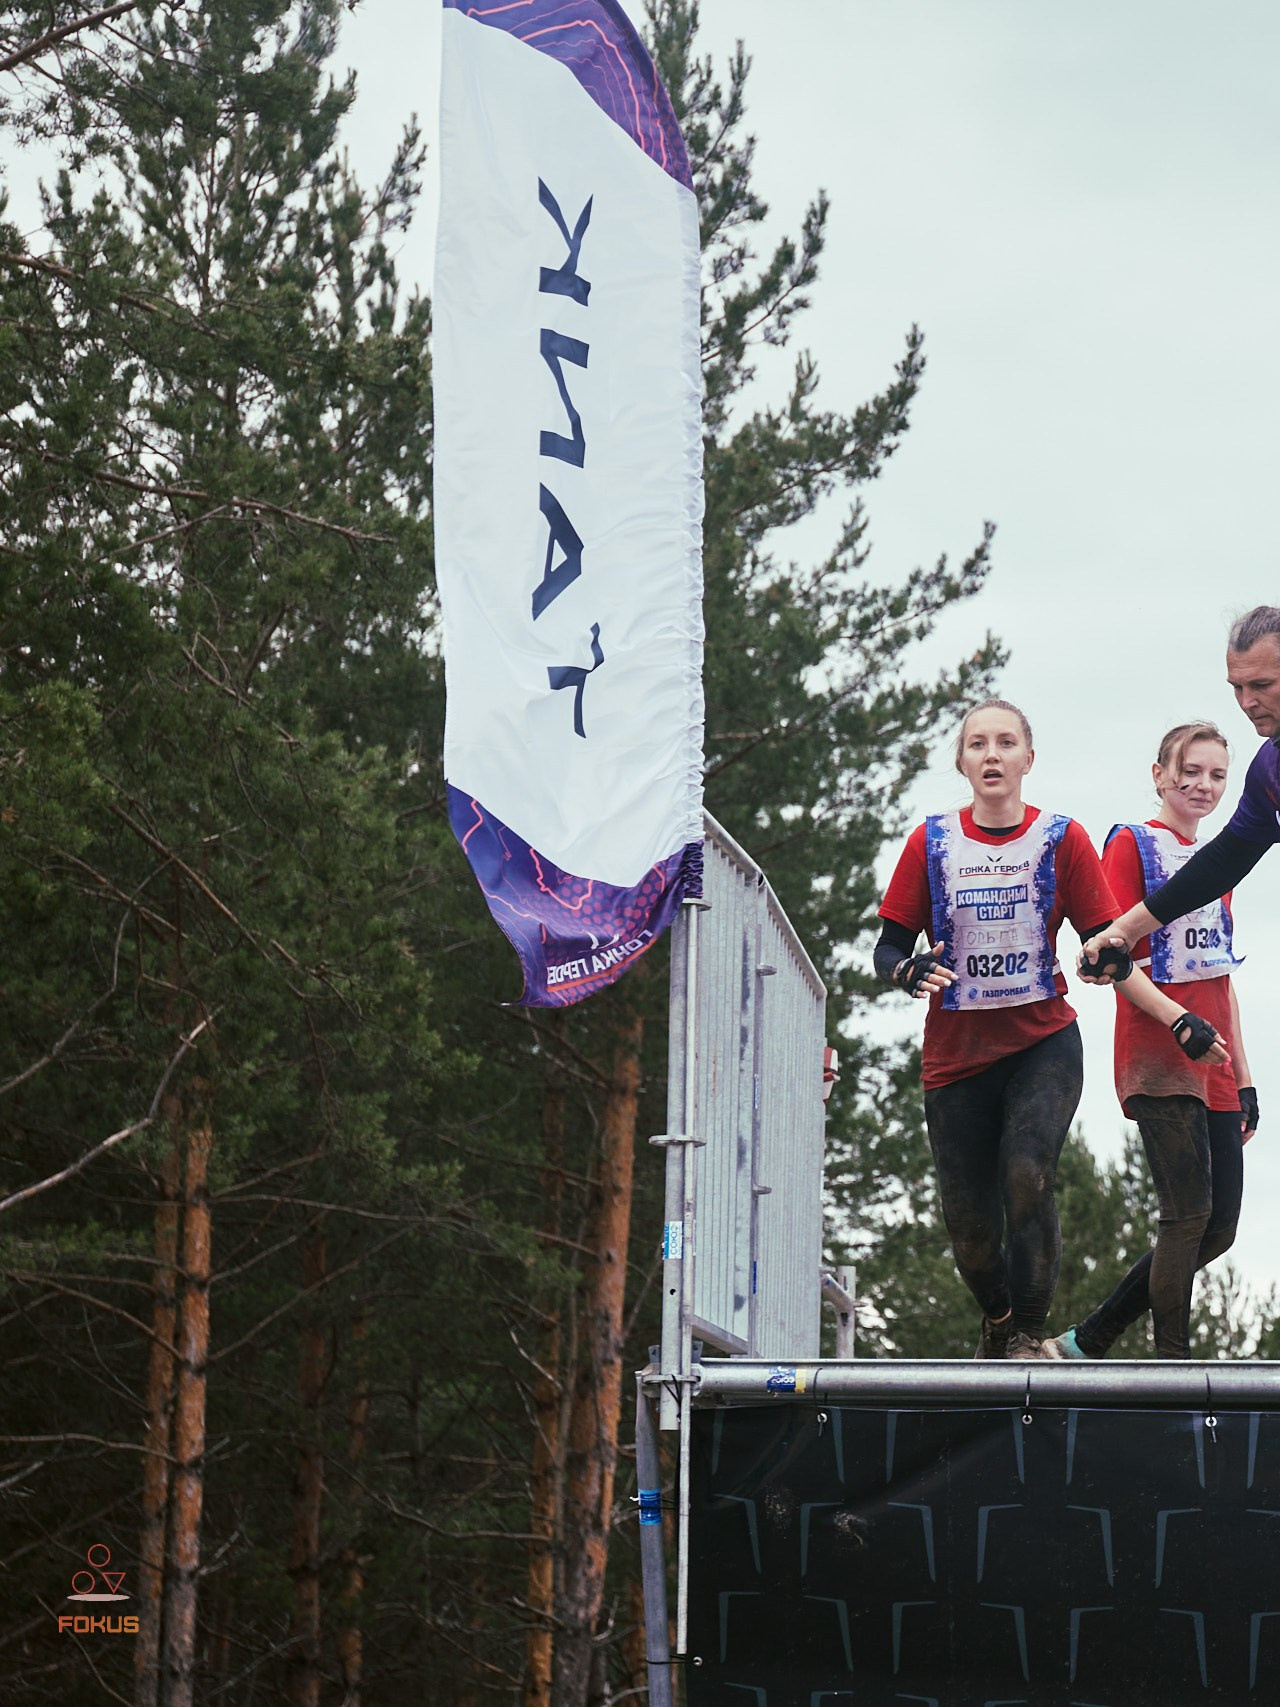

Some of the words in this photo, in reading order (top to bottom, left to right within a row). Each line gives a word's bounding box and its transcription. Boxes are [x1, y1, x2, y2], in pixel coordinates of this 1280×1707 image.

[959, 865, 991, 875] ГОНКА
[994, 860, 1030, 873] ГЕРОЕВ
[957, 884, 1027, 906] КОМАНДНЫЙ
[979, 905, 1014, 919] СТАРТ
[966, 951, 1029, 978] 03202
